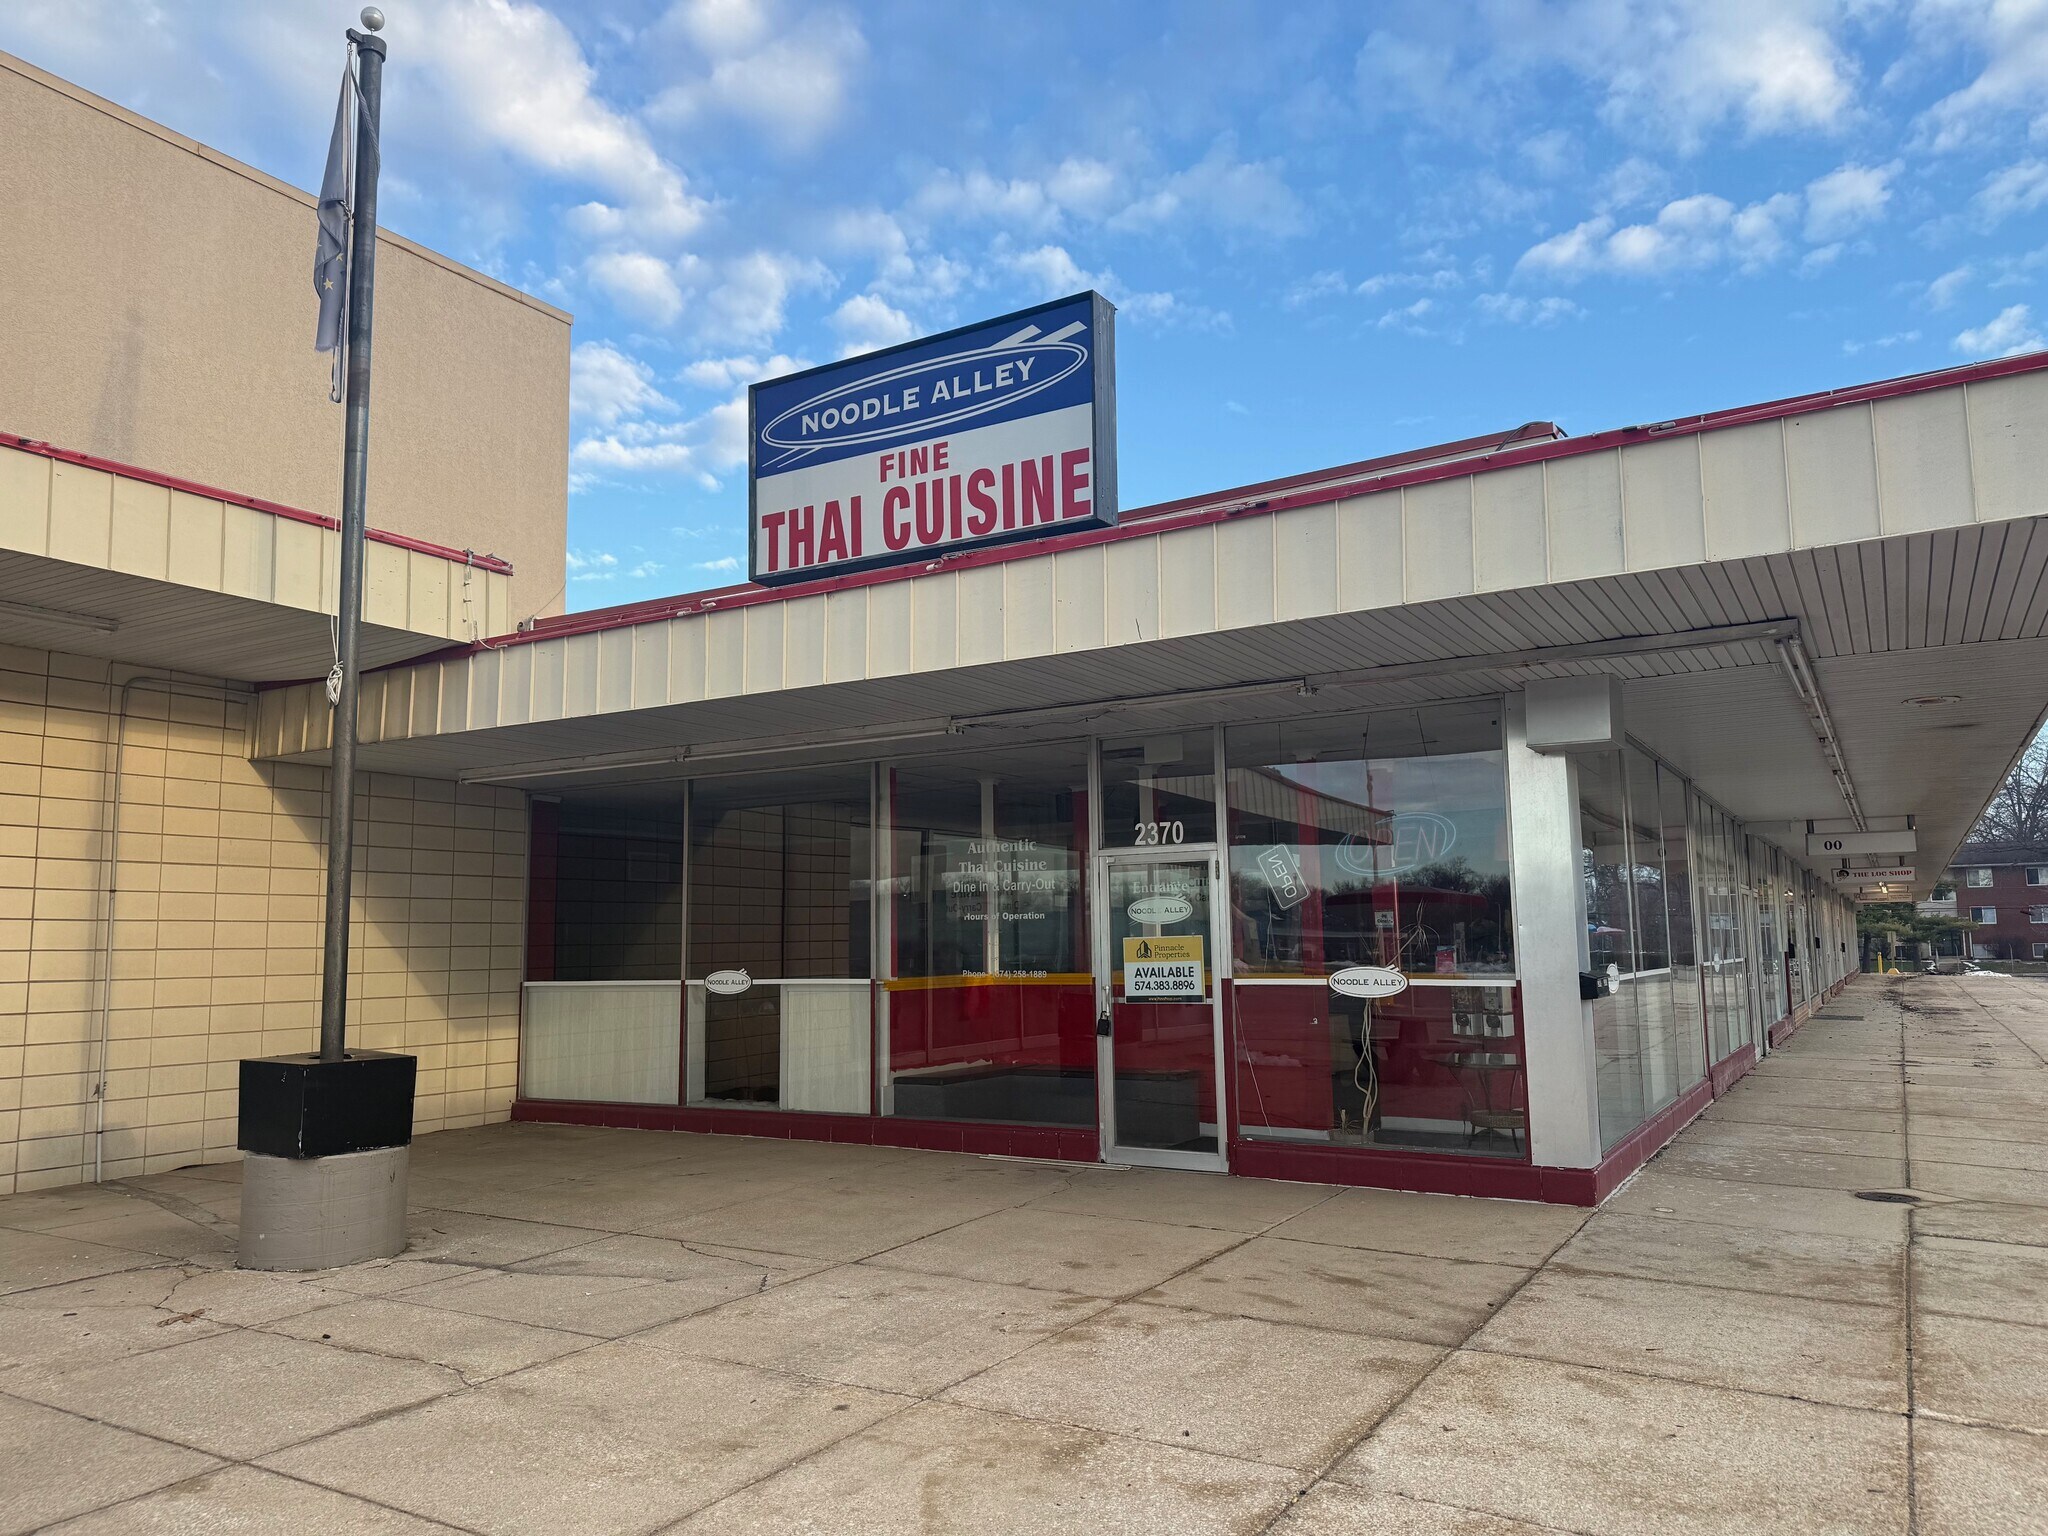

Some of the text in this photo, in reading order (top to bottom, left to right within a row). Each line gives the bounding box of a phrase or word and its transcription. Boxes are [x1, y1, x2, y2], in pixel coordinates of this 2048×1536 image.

[801, 356, 1036, 436] NOODLE ALLEY
[879, 441, 949, 483] FINE
[761, 447, 1091, 572] THAI CUISINE
[1134, 820, 1184, 846] 2370
[967, 839, 1037, 854] Authentic
[1350, 825, 1438, 863] OPEN
[1824, 840, 1842, 850] 00
[959, 859, 1047, 874] Thai Cuisine
[953, 881, 976, 893] Dine
[979, 880, 988, 892] In
[1003, 878, 1055, 893] Carry-Out
[1133, 880, 1189, 894] Entrance
[964, 912, 1045, 921] Hours of Operation
[1164, 906, 1189, 914] ALLEY
[1154, 944, 1185, 952] Pinnacle
[1154, 951, 1190, 960] Properties
[1134, 966, 1195, 979] AVAILABLE
[1134, 980, 1195, 991] 574.383.8896
[1333, 978, 1402, 987] NOODLE ALLEY
